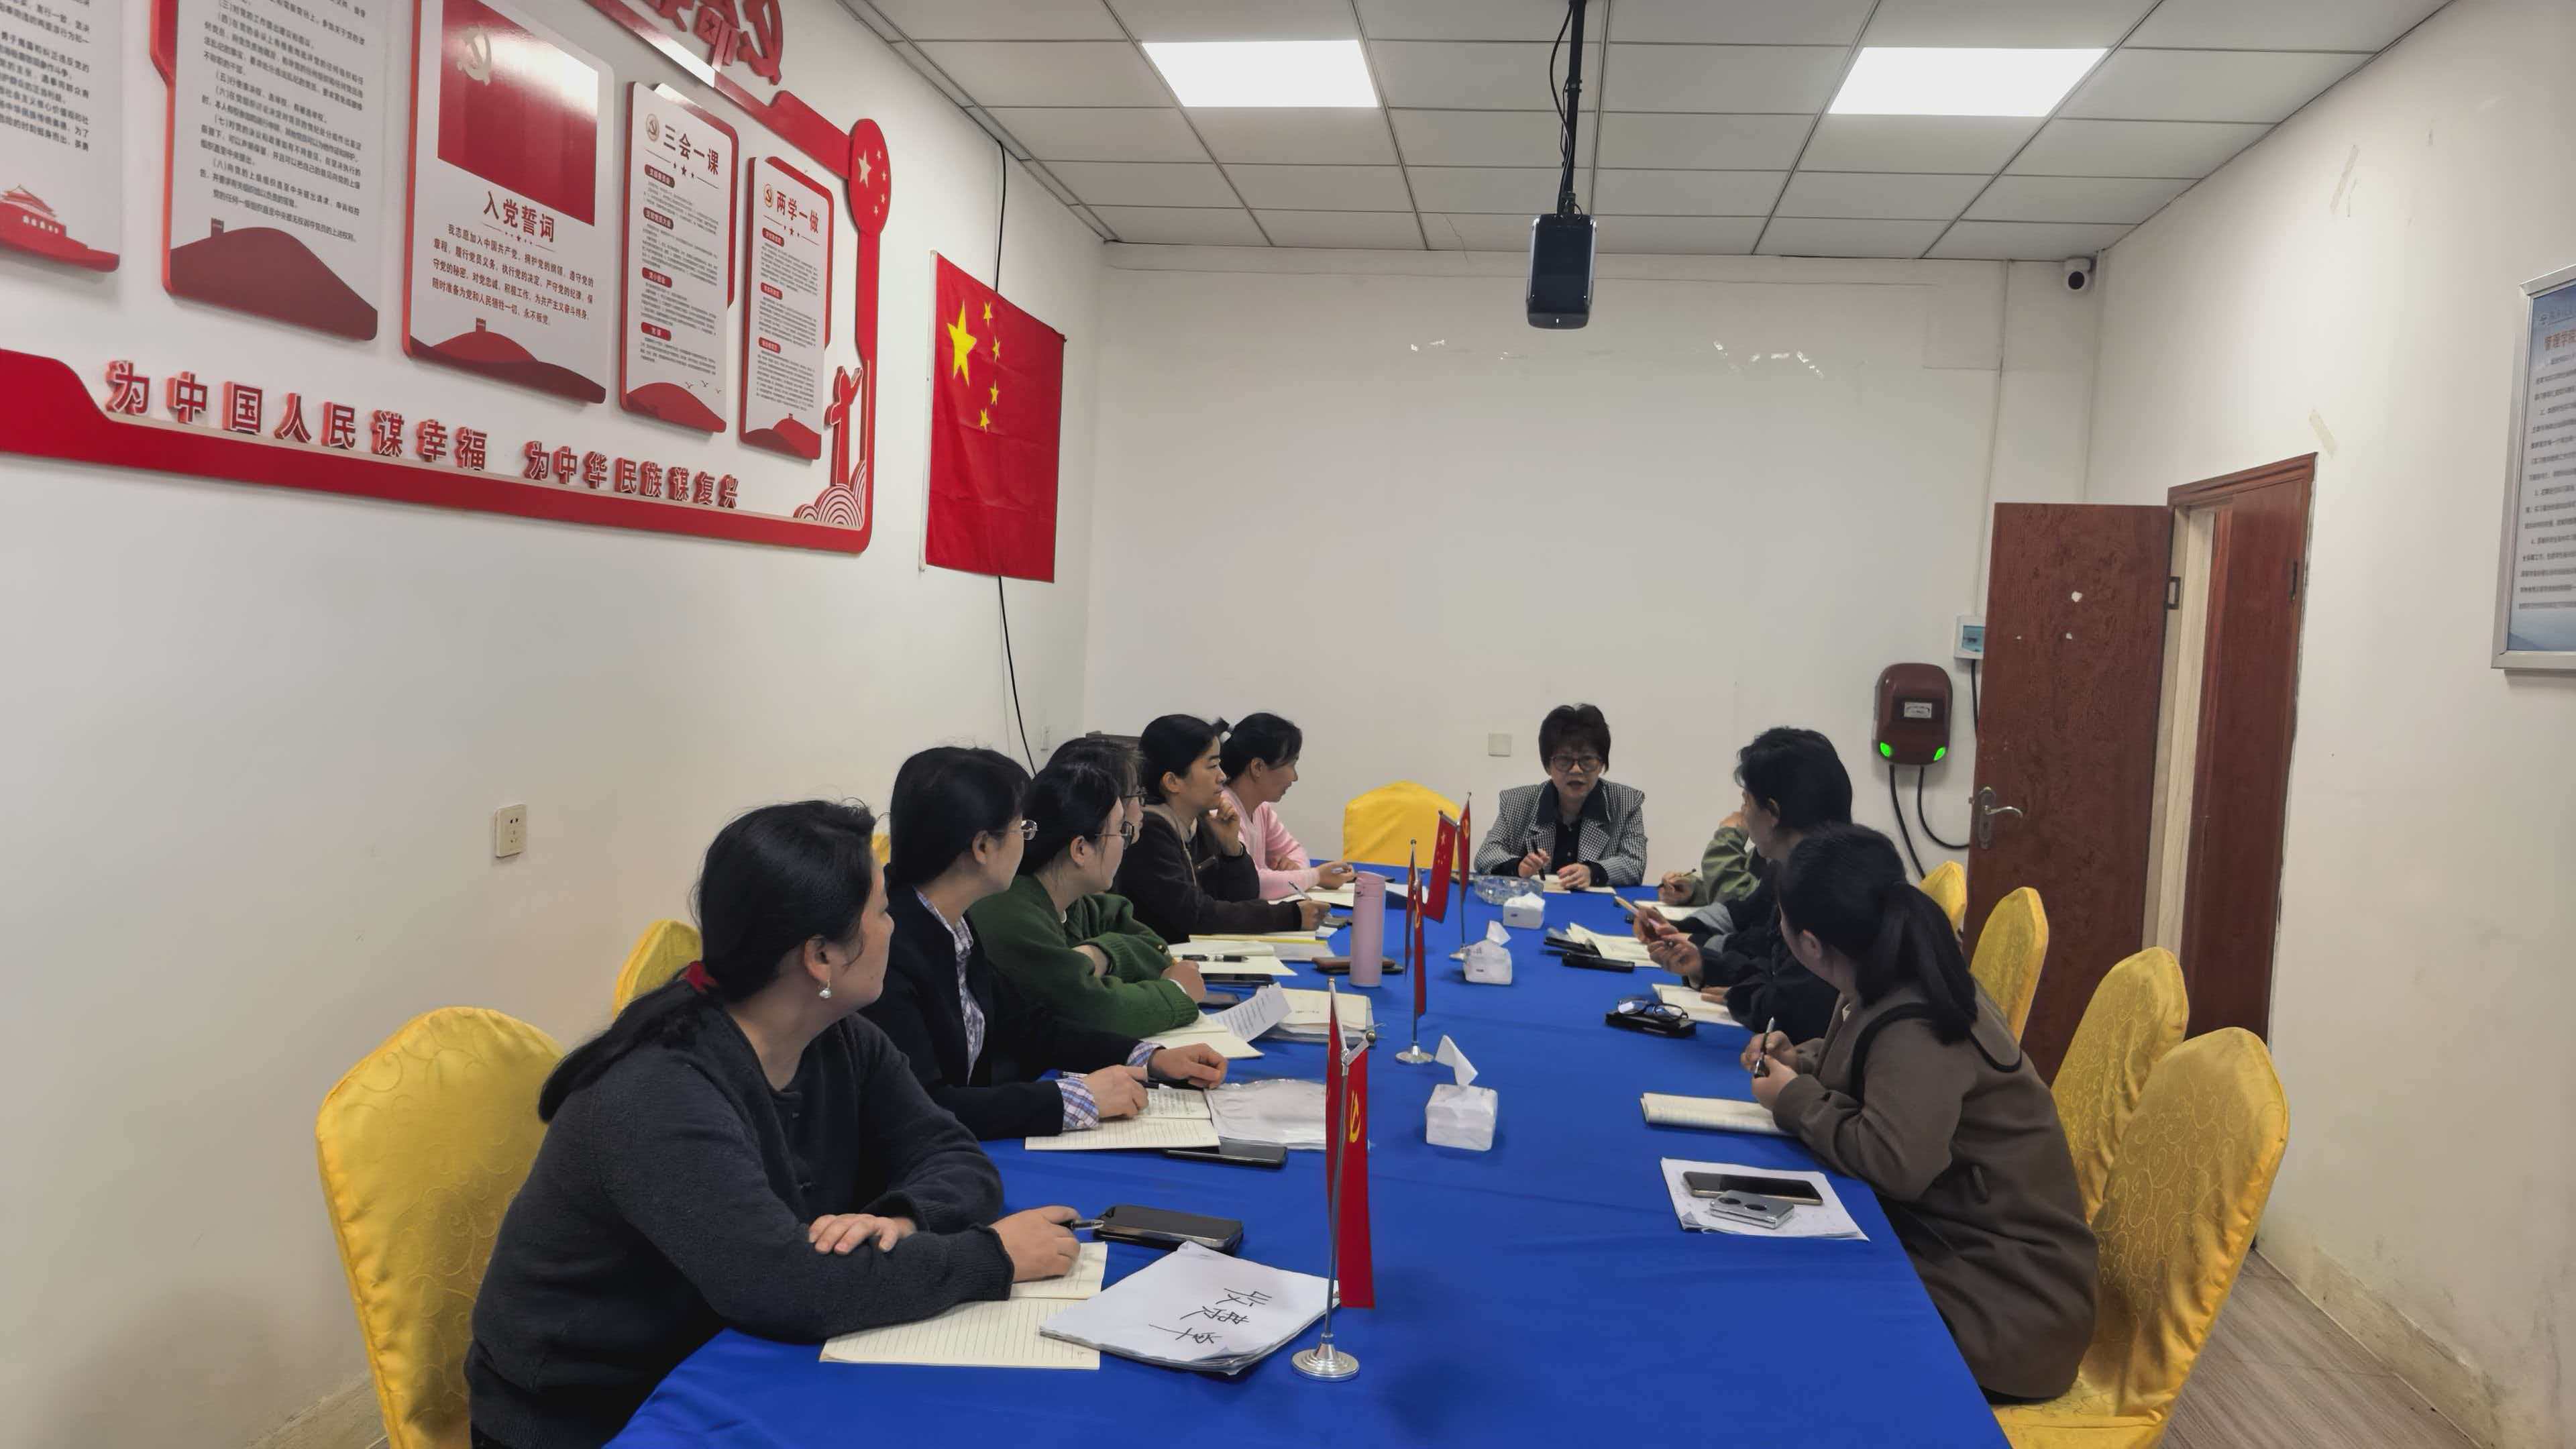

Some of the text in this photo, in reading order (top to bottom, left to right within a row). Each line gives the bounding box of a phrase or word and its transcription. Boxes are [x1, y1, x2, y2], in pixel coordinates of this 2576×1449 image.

[663, 124, 719, 175] 三会一课
[482, 190, 555, 243] 入党誓词
[777, 191, 818, 234] 两学一做
[105, 360, 739, 508] 为中国人民谋幸福 为中华民族谋复兴
